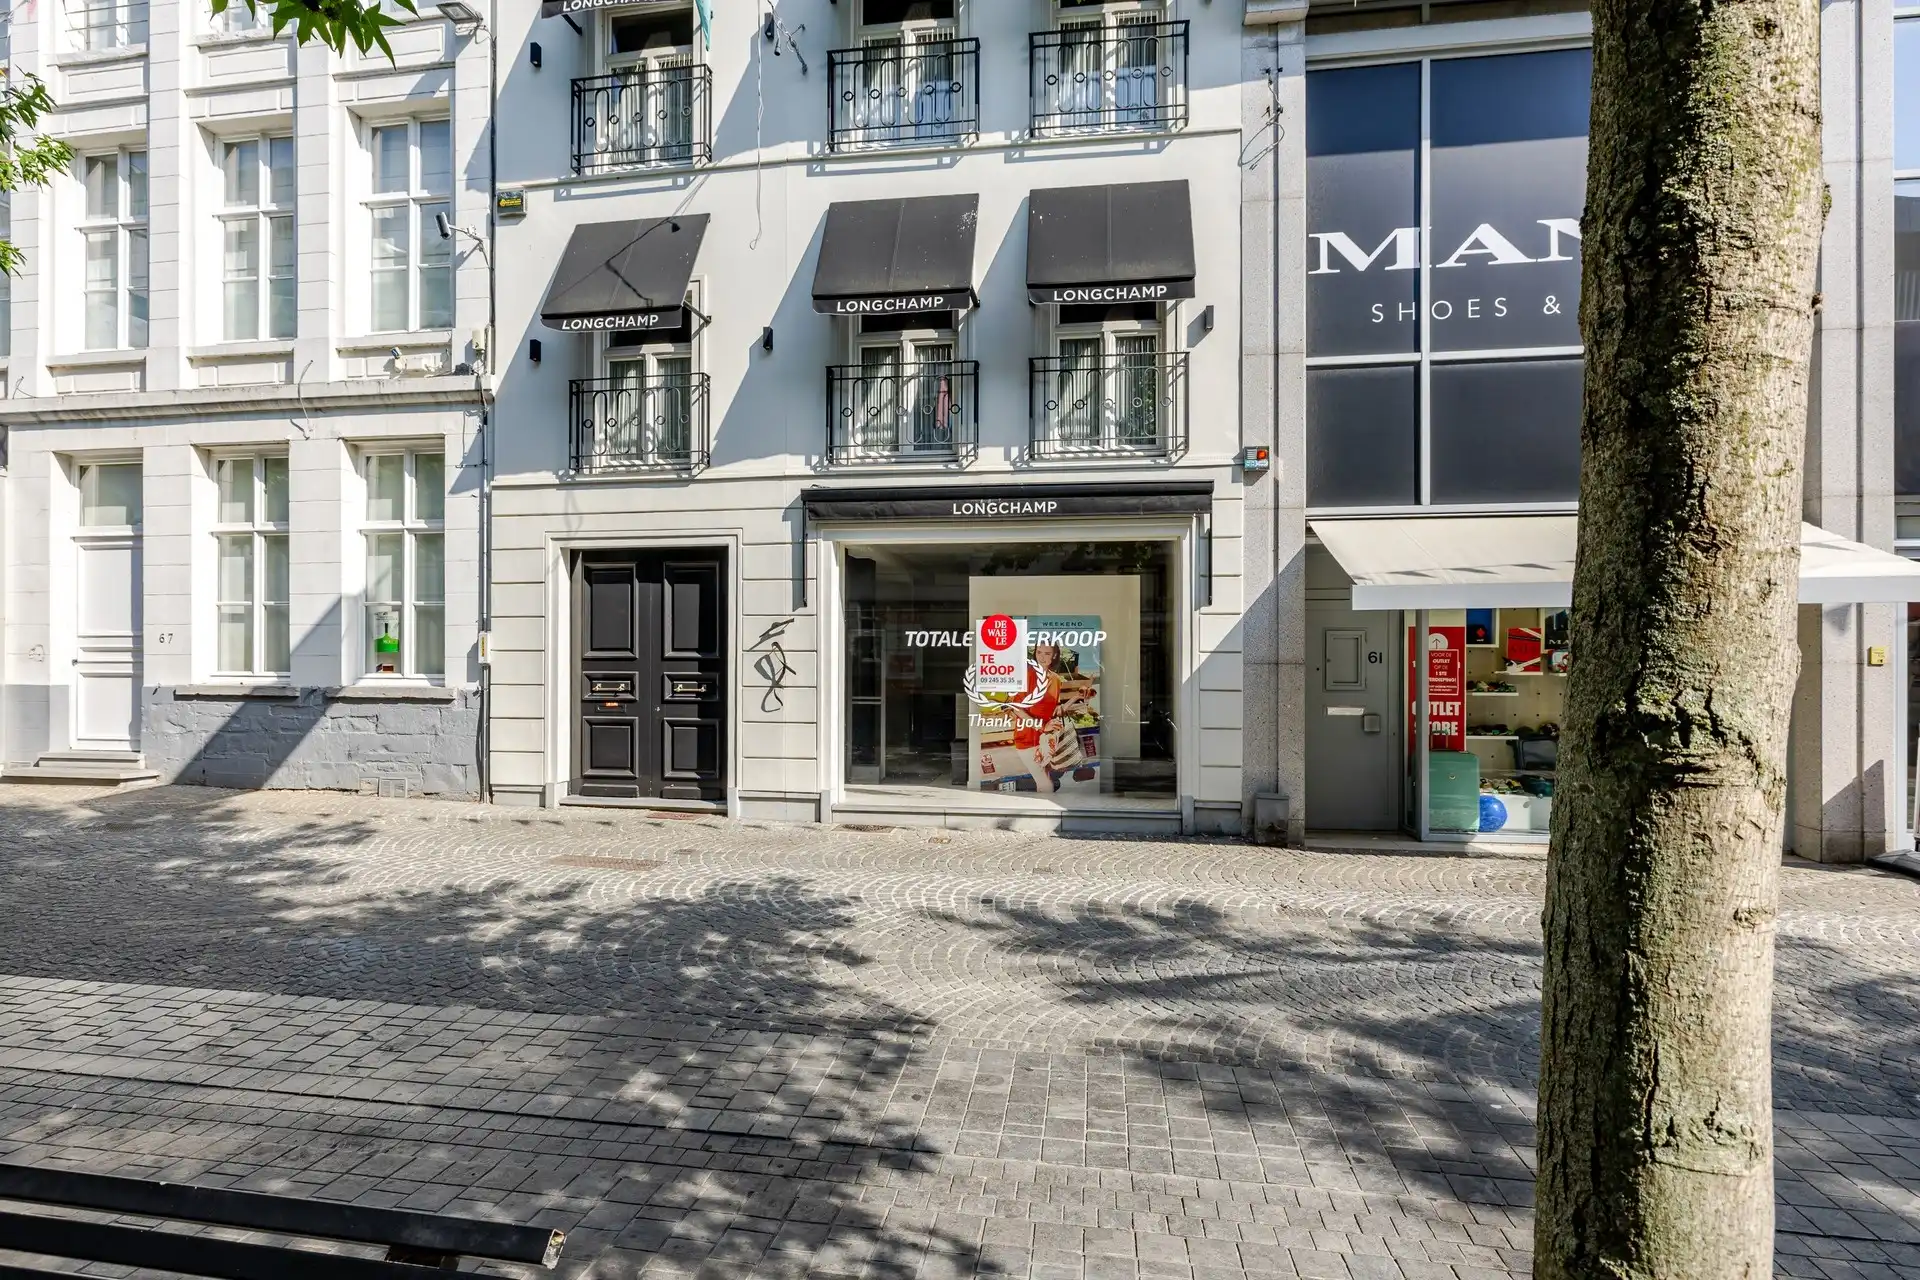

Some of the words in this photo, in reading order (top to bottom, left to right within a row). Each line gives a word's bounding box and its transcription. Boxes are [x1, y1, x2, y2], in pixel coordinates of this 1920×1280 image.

[563, 0, 658, 12] LONGC
[1053, 285, 1167, 301] LONGCHAMP
[836, 296, 944, 312] LONGCHAMP
[1371, 297, 1508, 323] SHOES
[1543, 295, 1562, 315] &
[561, 314, 659, 330] LONGCHAMP
[952, 501, 1058, 515] LONGCHAMP
[994, 620, 1007, 629] DE
[159, 633, 173, 644] 67
[905, 631, 974, 647] TOTALE
[1025, 631, 1107, 647] ERKOOP
[987, 629, 1007, 637] WAE
[995, 638, 1007, 646] LE
[980, 654, 995, 664] TE
[1368, 651, 1383, 664] 61
[980, 665, 1015, 675] KOOP
[1412, 701, 1462, 717] OTLET
[968, 714, 1012, 728] Thank
[1016, 716, 1043, 731] you
[1414, 721, 1459, 736] ORE
